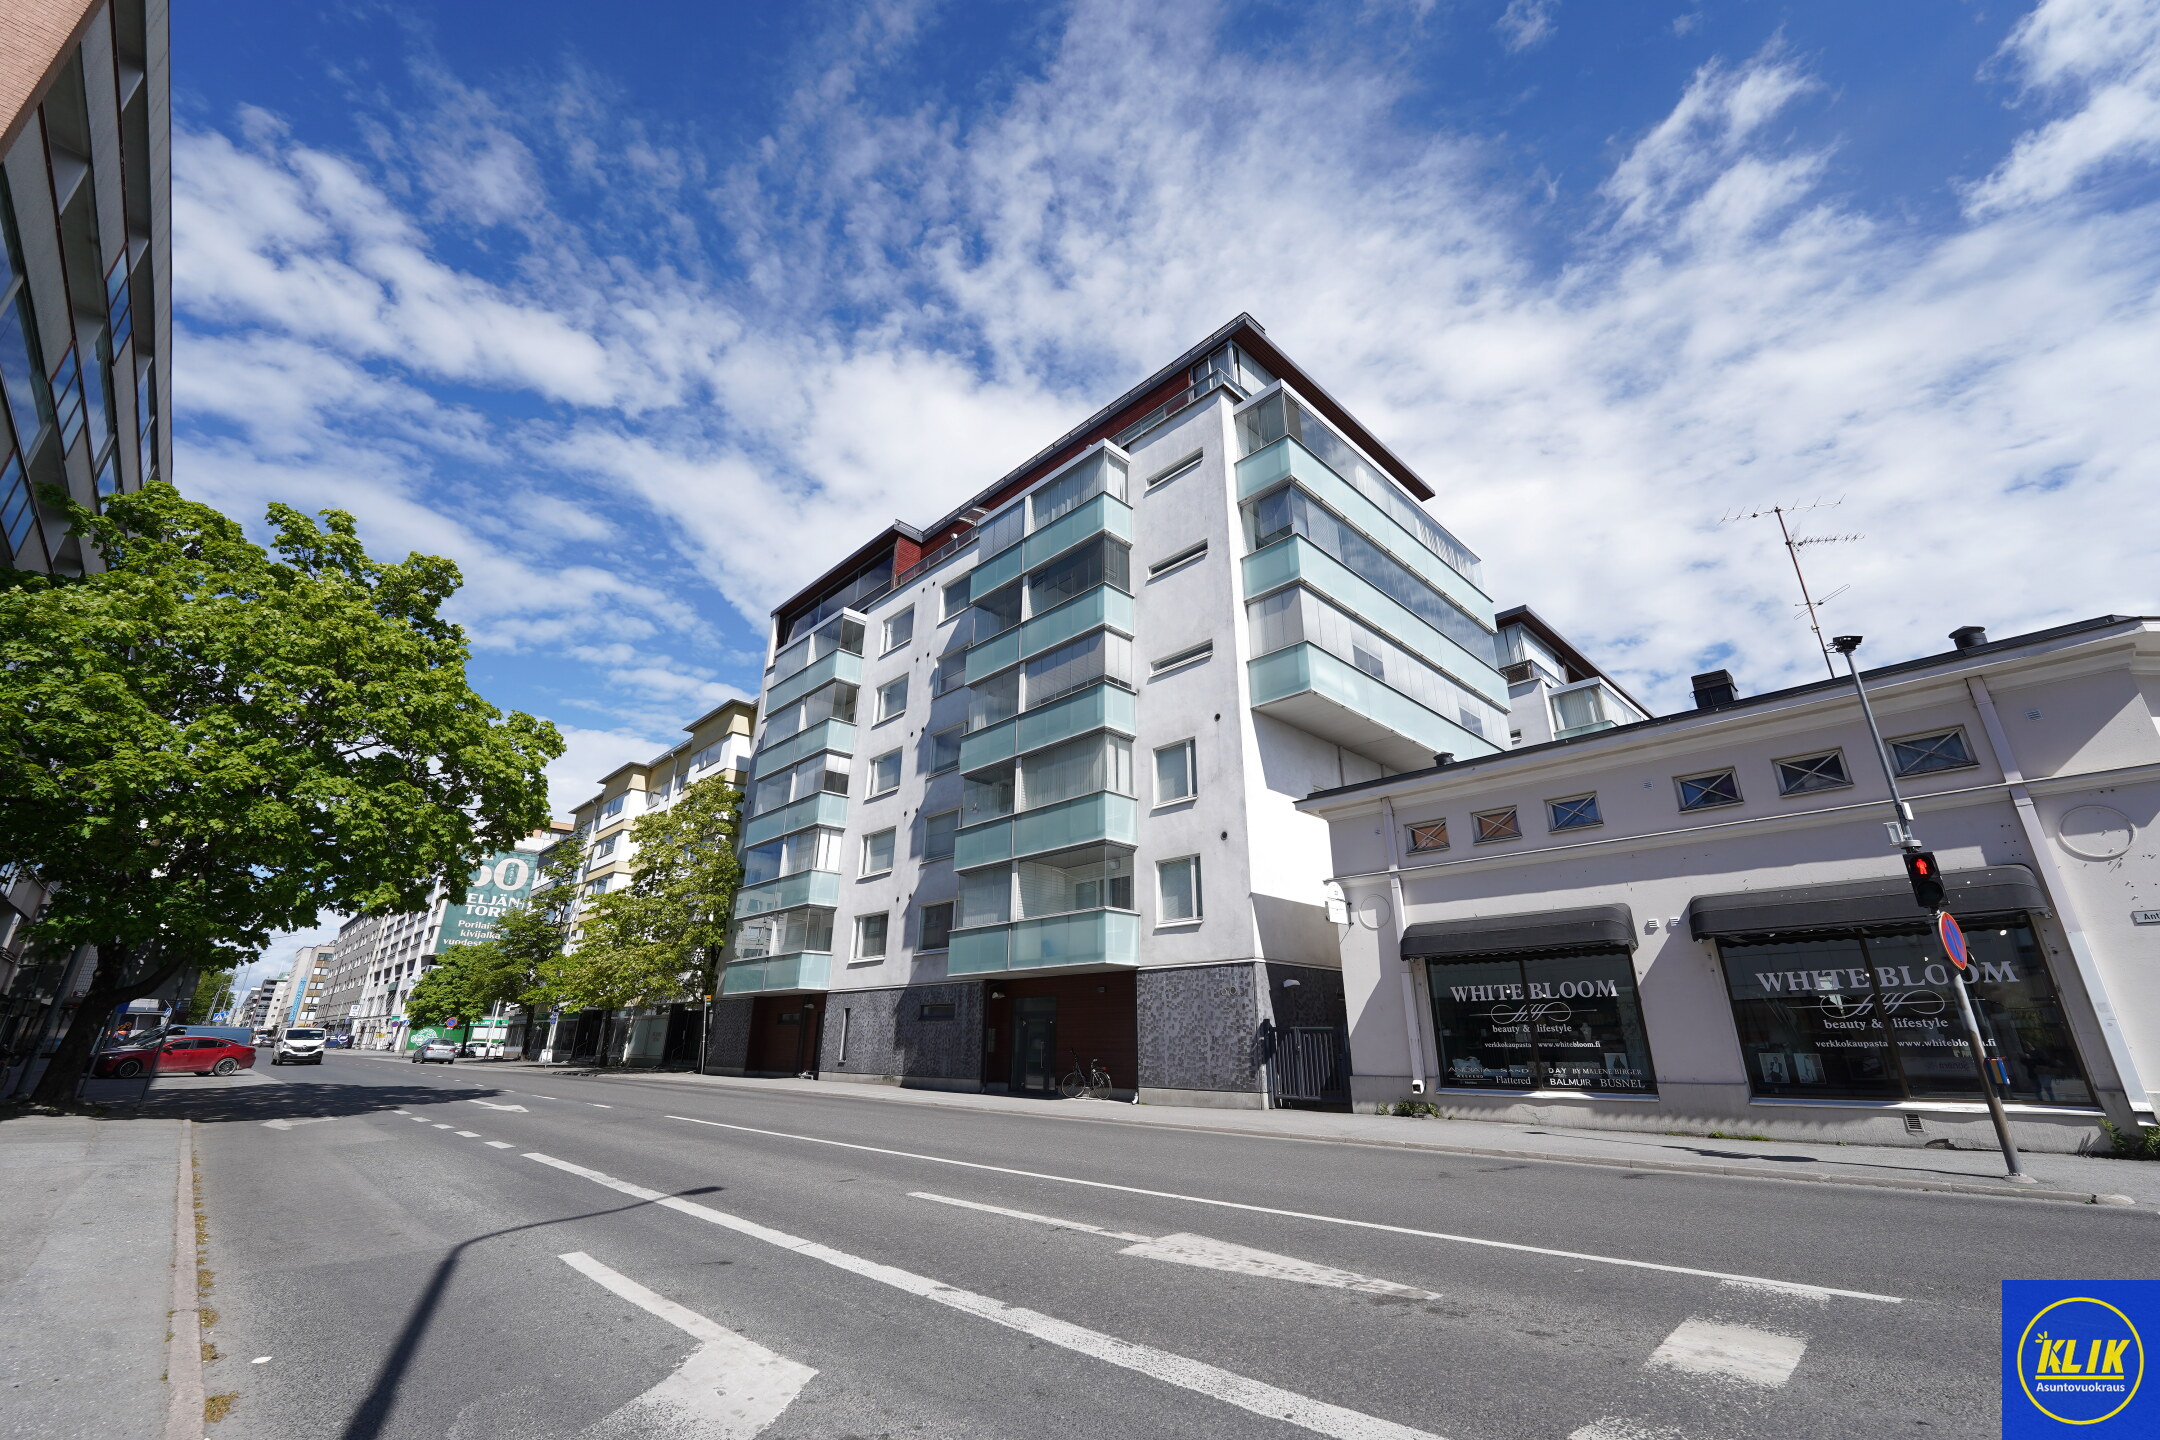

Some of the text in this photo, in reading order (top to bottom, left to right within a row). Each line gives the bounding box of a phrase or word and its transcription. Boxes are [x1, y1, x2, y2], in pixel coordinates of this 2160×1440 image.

[1755, 967, 1871, 992] WHITE
[1450, 980, 1619, 1002] WHITE BLOOM
[1492, 1023, 1572, 1033] beauty & lifestyle
[1823, 1017, 1949, 1031] beauty & lifestyle
[1484, 1040, 1601, 1049] verkkokaupasta www.whitebloom.fi
[1815, 1038, 1997, 1049] verkkokaupasta www.whiteblo.fi
[1495, 1075, 1532, 1085] Flattered
[1549, 1078, 1592, 1087] BALMUIR
[1600, 1078, 1646, 1089] BUSNEL
